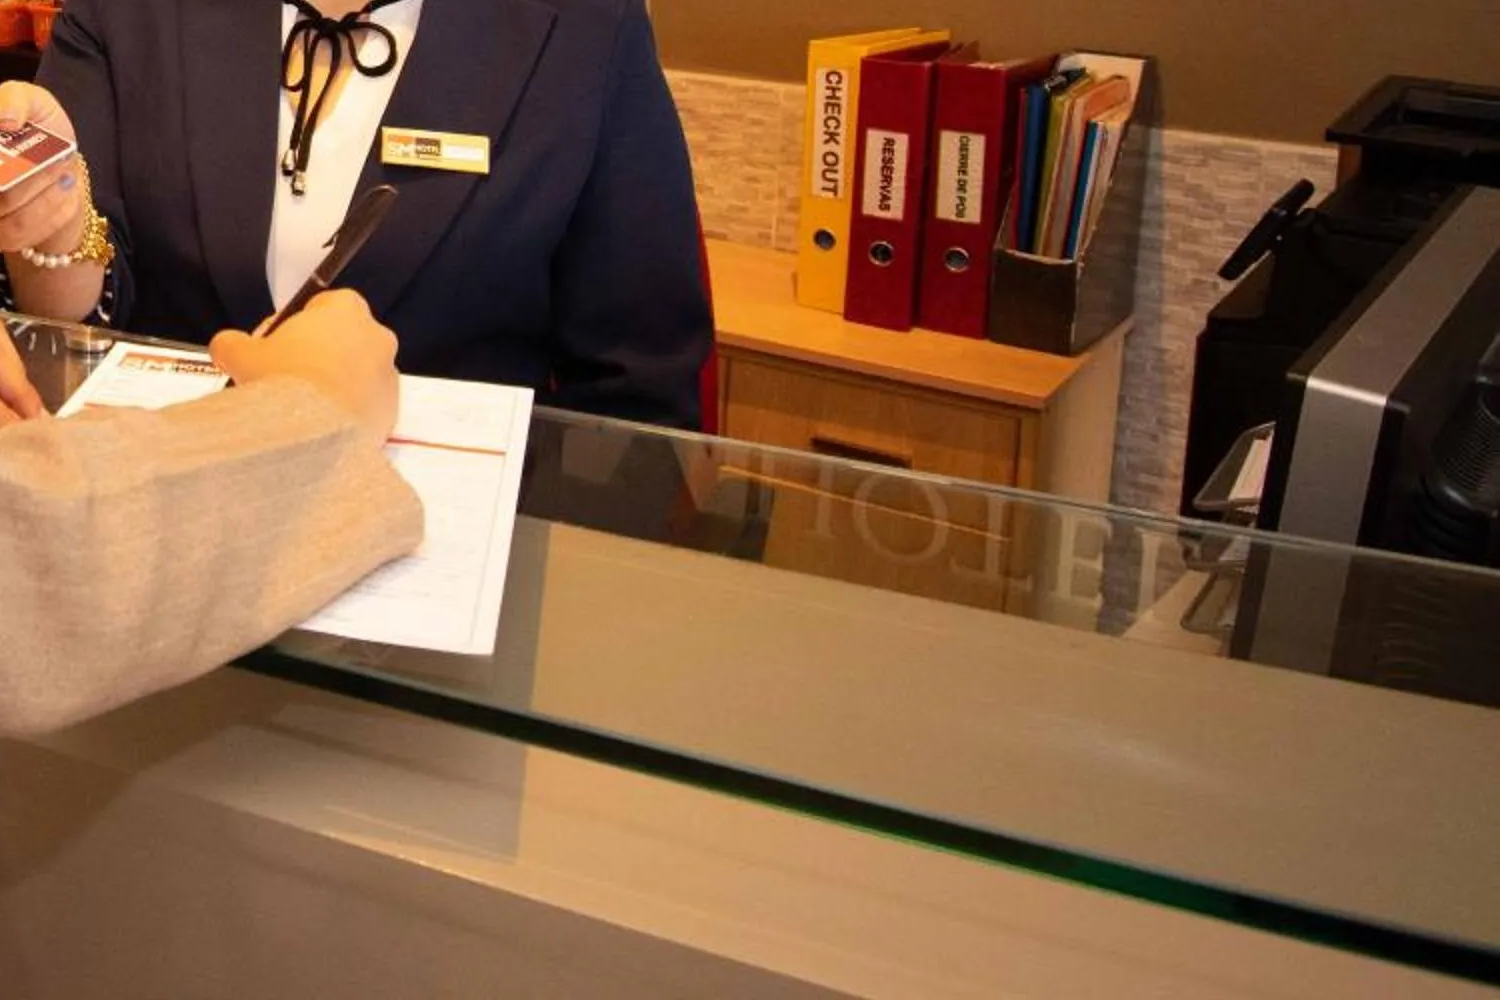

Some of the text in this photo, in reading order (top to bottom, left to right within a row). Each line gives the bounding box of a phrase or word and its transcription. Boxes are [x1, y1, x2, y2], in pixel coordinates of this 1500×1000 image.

[821, 70, 843, 197] CHECK OUT
[878, 137, 896, 212] RESERVAS
